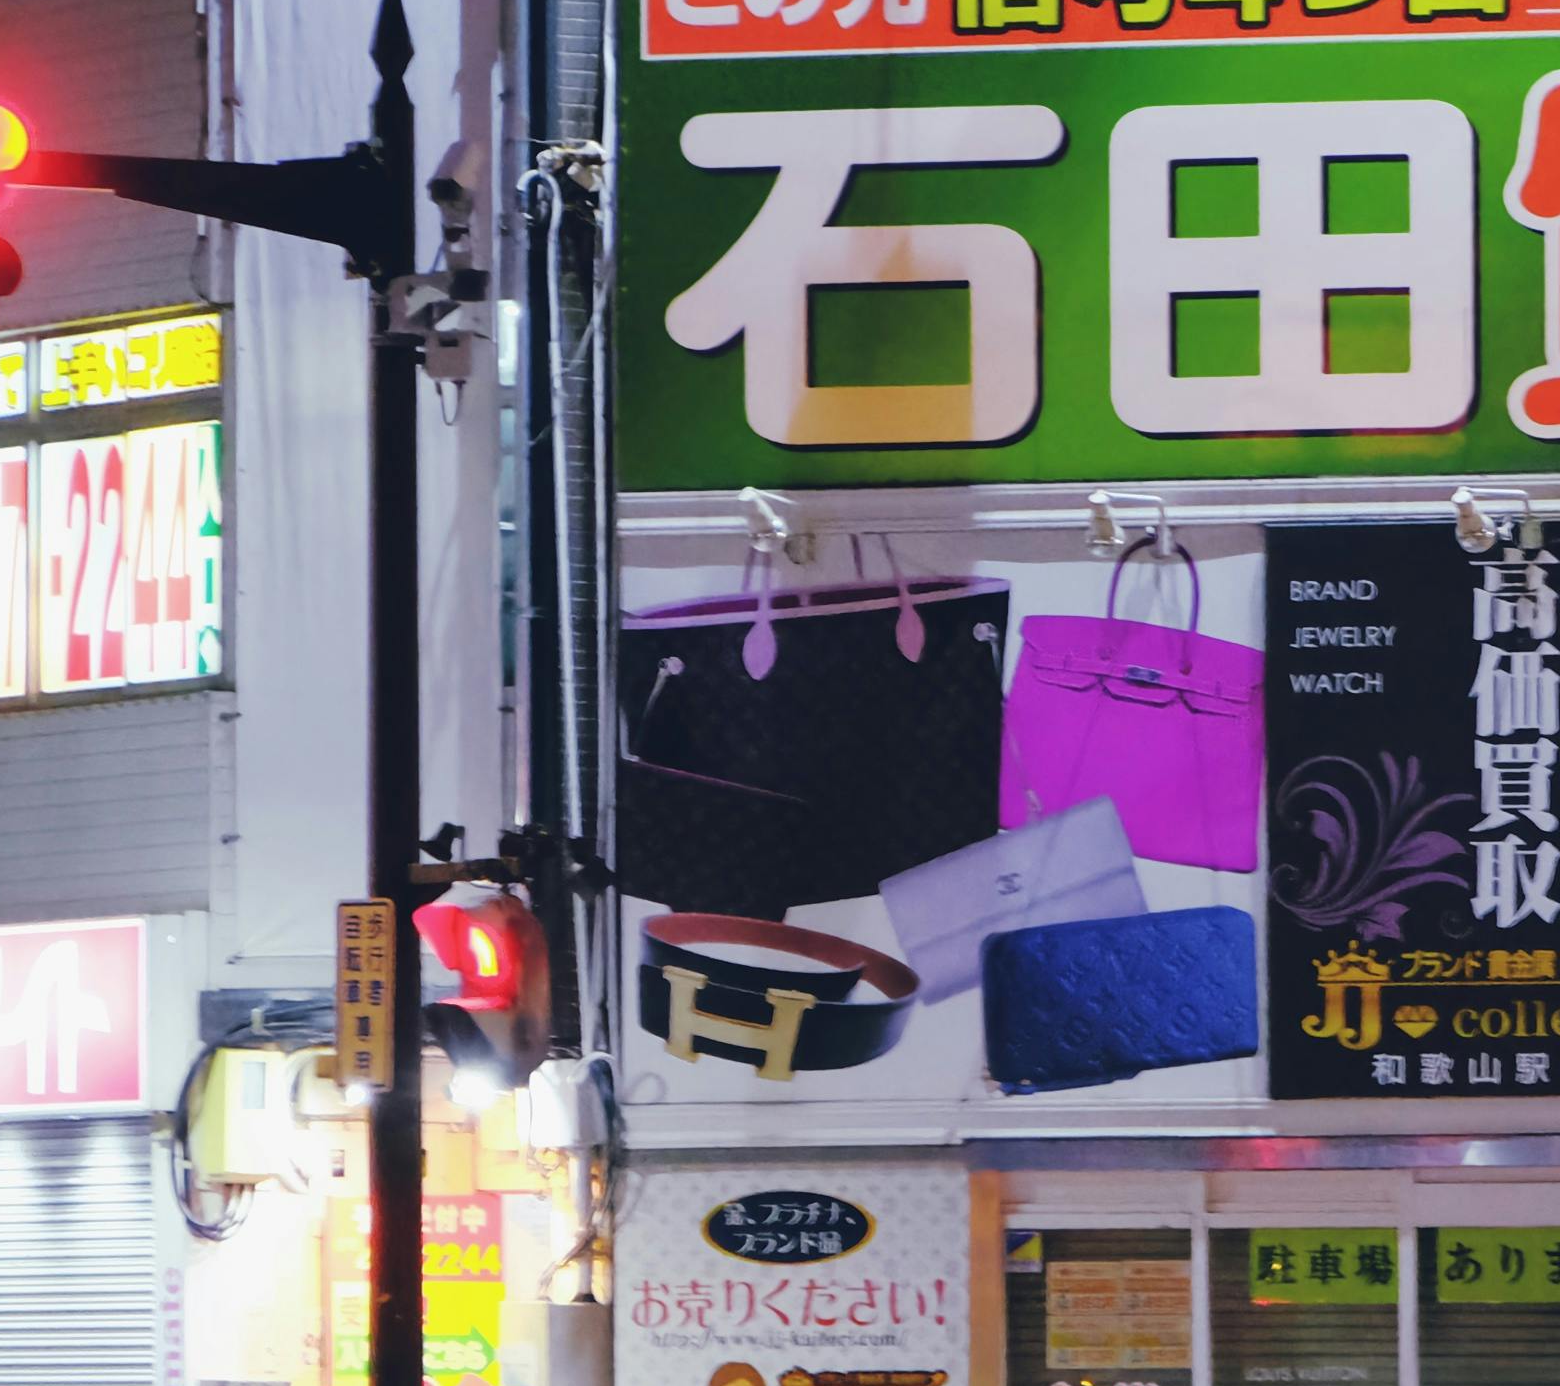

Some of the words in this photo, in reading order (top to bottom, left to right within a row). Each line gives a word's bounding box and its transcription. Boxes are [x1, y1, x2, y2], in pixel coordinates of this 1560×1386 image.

[1288, 579, 1380, 603] BRAND
[1288, 625, 1398, 649] JEWELRY
[1288, 671, 1385, 695] WATCH
[1256, 1242, 1394, 1286] 駐車場
[631, 1278, 947, 1328] お売りください!
